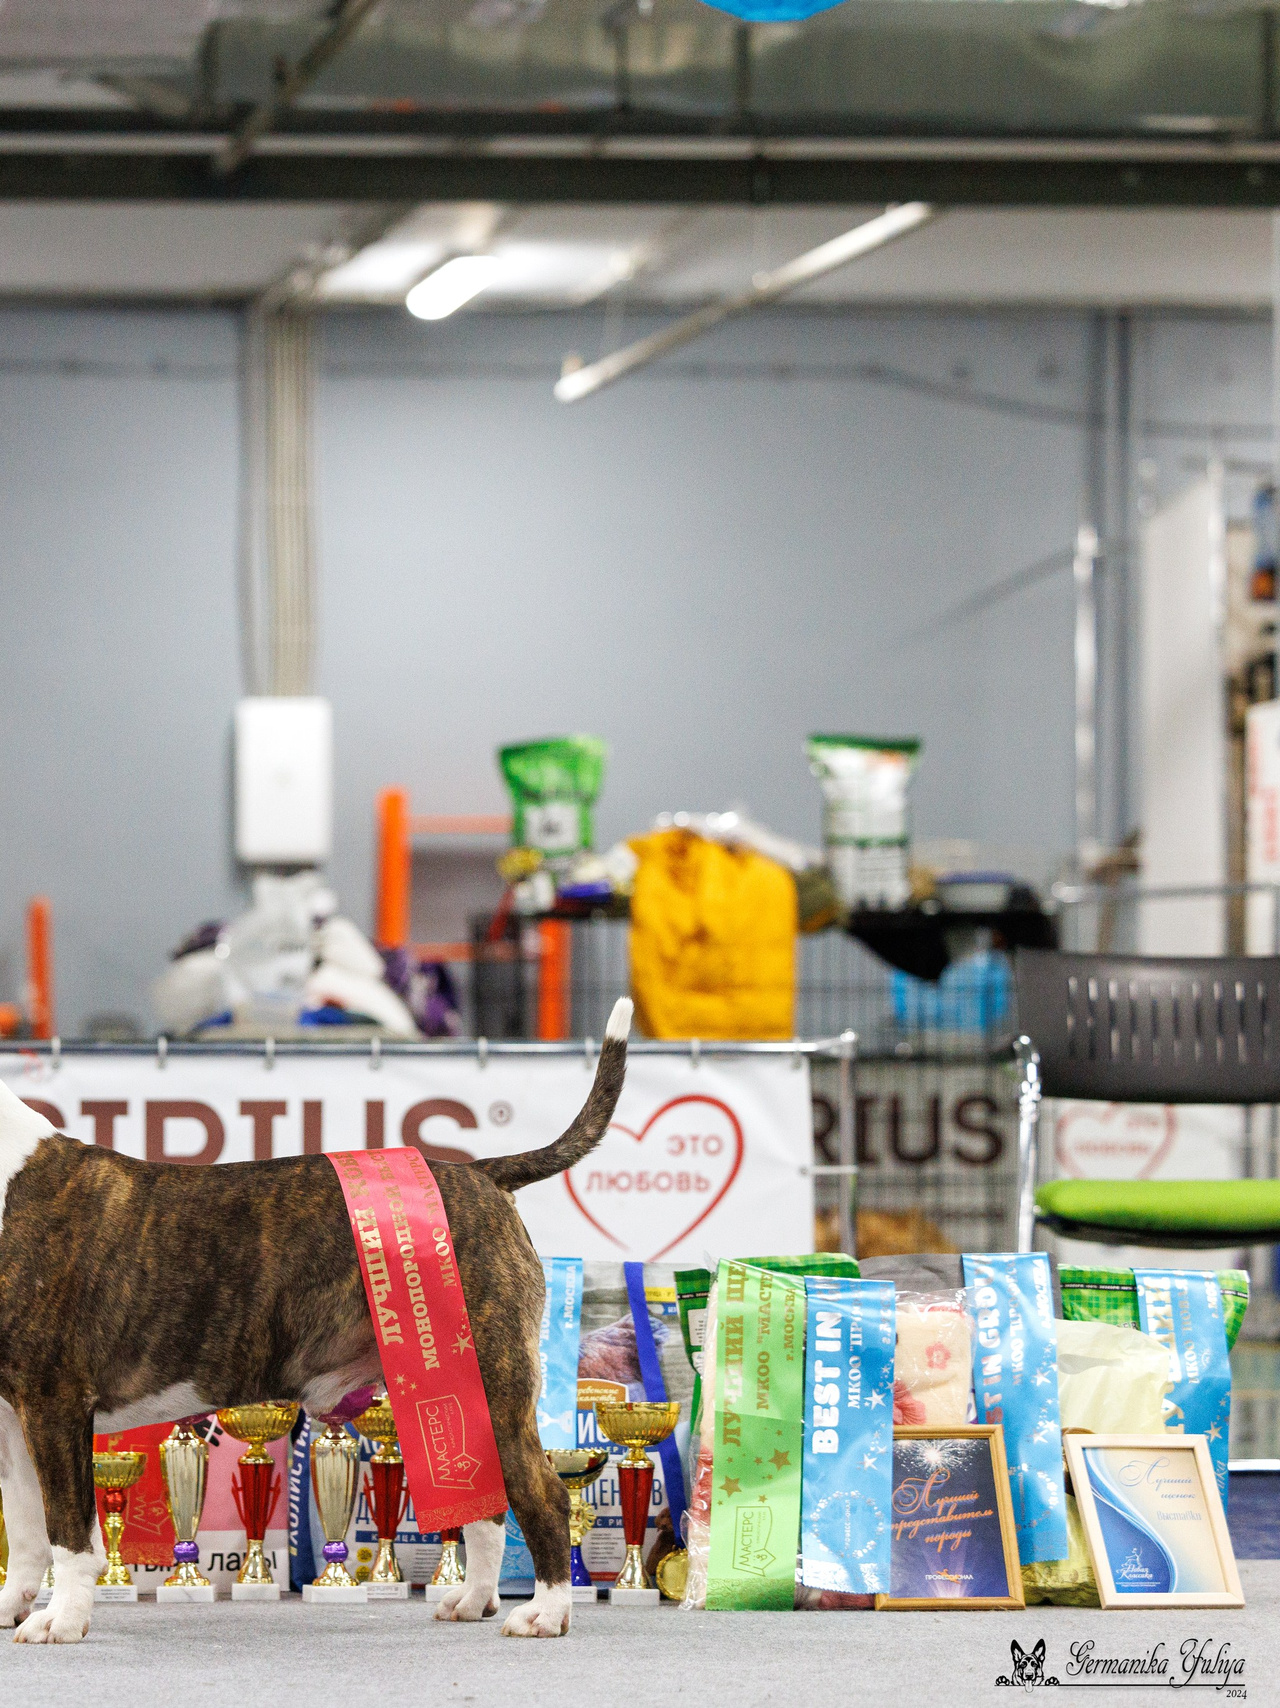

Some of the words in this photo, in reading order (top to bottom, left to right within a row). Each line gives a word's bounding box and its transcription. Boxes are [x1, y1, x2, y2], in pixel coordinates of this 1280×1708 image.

[667, 1134, 724, 1157] ЭТО
[585, 1170, 712, 1193] ЛЮБОВЬ
[351, 1205, 404, 1347] ЛУЧШИЙ
[385, 1184, 440, 1372] МОНОПОРОДНОЙ
[431, 1226, 457, 1288] МКОО
[783, 1287, 796, 1362] г.МОСКВА
[815, 1311, 843, 1353] IN
[719, 1315, 744, 1448] ЛУЧШИЙ
[756, 1350, 770, 1411] МКОО
[847, 1354, 862, 1409] МКОО
[981, 1353, 1003, 1386] IN
[1010, 1337, 1025, 1386] МКОО
[812, 1359, 841, 1454] BEST
[425, 1404, 454, 1481] МАСТЕРС
[892, 1467, 980, 1516] Лучший
[737, 1511, 755, 1567] МАСТЕРС
[924, 1529, 972, 1553] породы
